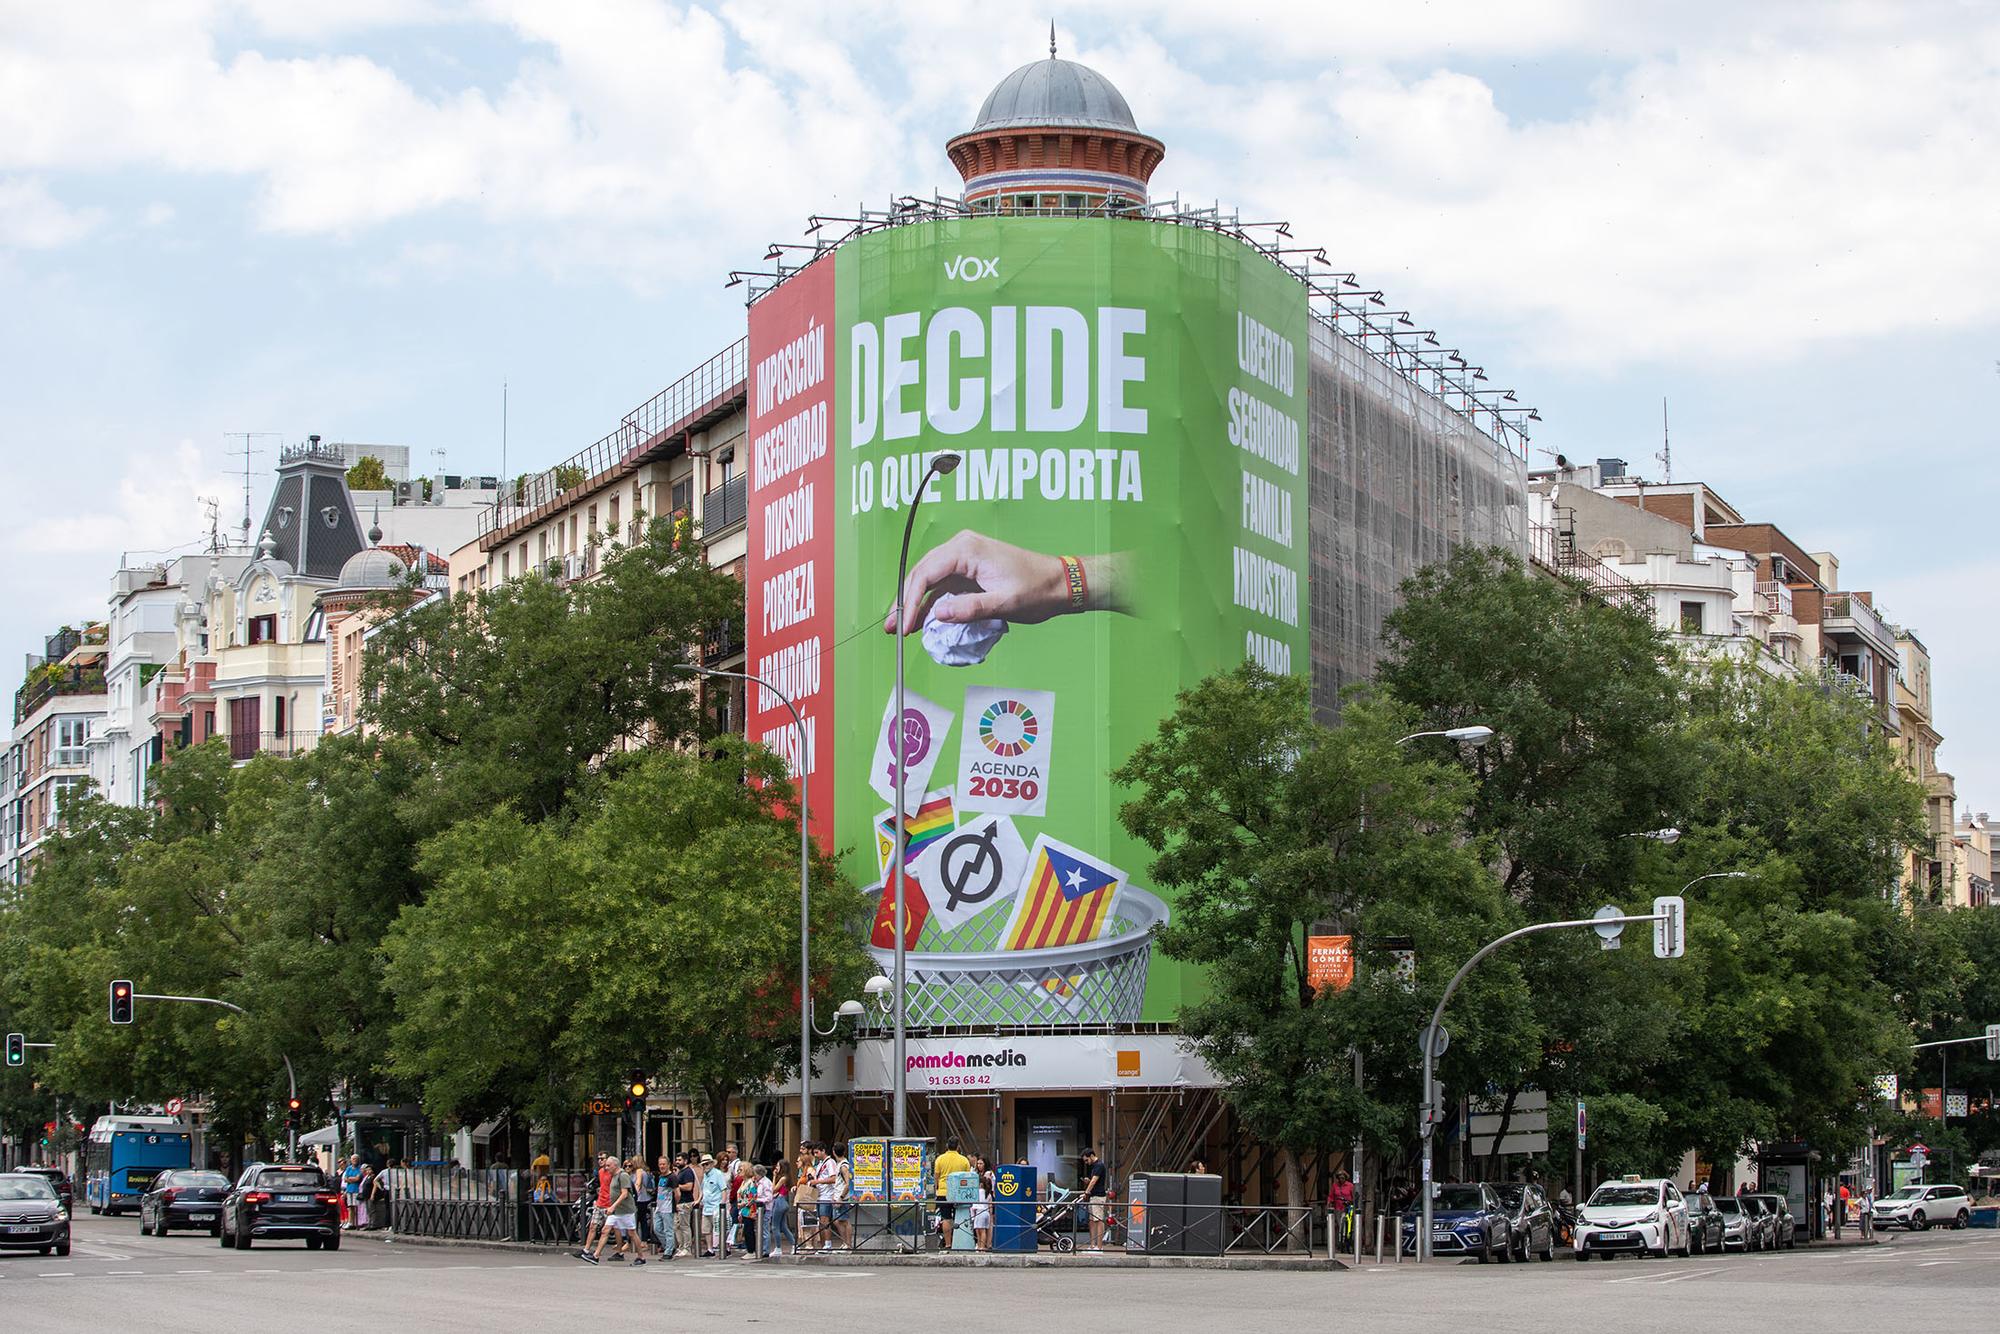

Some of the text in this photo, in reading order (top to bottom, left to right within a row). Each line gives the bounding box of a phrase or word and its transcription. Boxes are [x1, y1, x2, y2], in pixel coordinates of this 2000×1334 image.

[944, 255, 1000, 282] VOX
[757, 315, 825, 419] IMPOSICIÓN
[851, 306, 1148, 449] DECIDE
[1238, 311, 1294, 398] LIBERTAD
[755, 400, 827, 493] INSEGURIDAD
[1228, 387, 1299, 477] SEGURIDAD
[764, 472, 814, 561] DIVISIÓN
[852, 448, 1143, 516] LO QUE IMPORTA
[1242, 471, 1293, 549] FAMILIA
[763, 560, 815, 637] POBREZA
[1233, 545, 1298, 628] INDUSTRIA
[758, 635, 821, 714] ABANDONO
[969, 776, 1039, 801] 2030
[970, 761, 1040, 778] AGENDA
[1312, 947, 1348, 955] FERNÁN
[1312, 955, 1348, 963] GÓMEZ
[906, 1049, 1027, 1073] pamdamedia
[928, 1075, 991, 1085] 91 633 68 42
